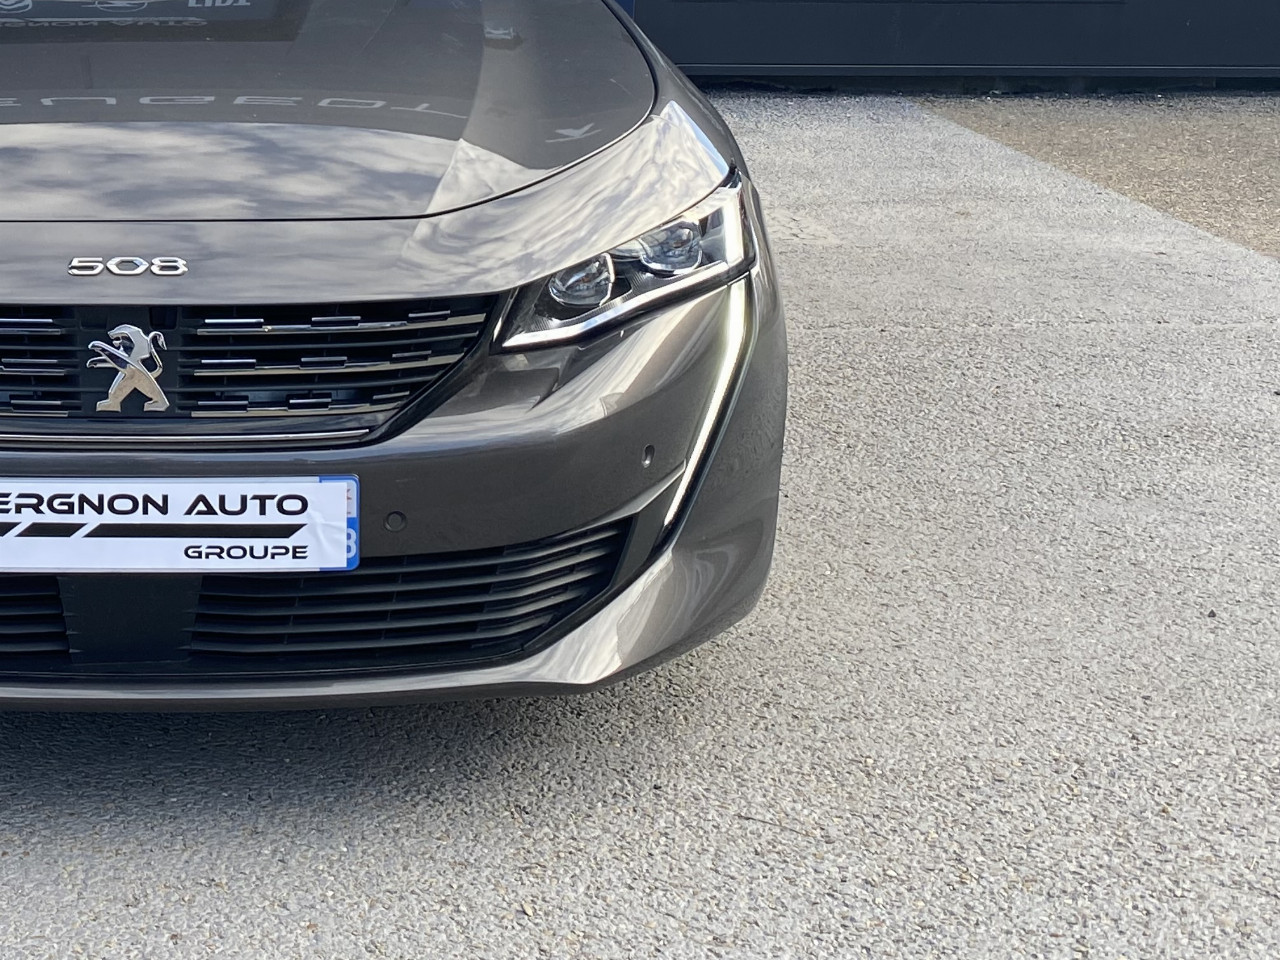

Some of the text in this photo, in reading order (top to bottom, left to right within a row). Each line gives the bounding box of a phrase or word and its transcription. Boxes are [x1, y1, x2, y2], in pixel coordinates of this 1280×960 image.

[67, 256, 189, 275] 508
[183, 493, 309, 516] AUTO
[183, 545, 309, 560] GROUPE
